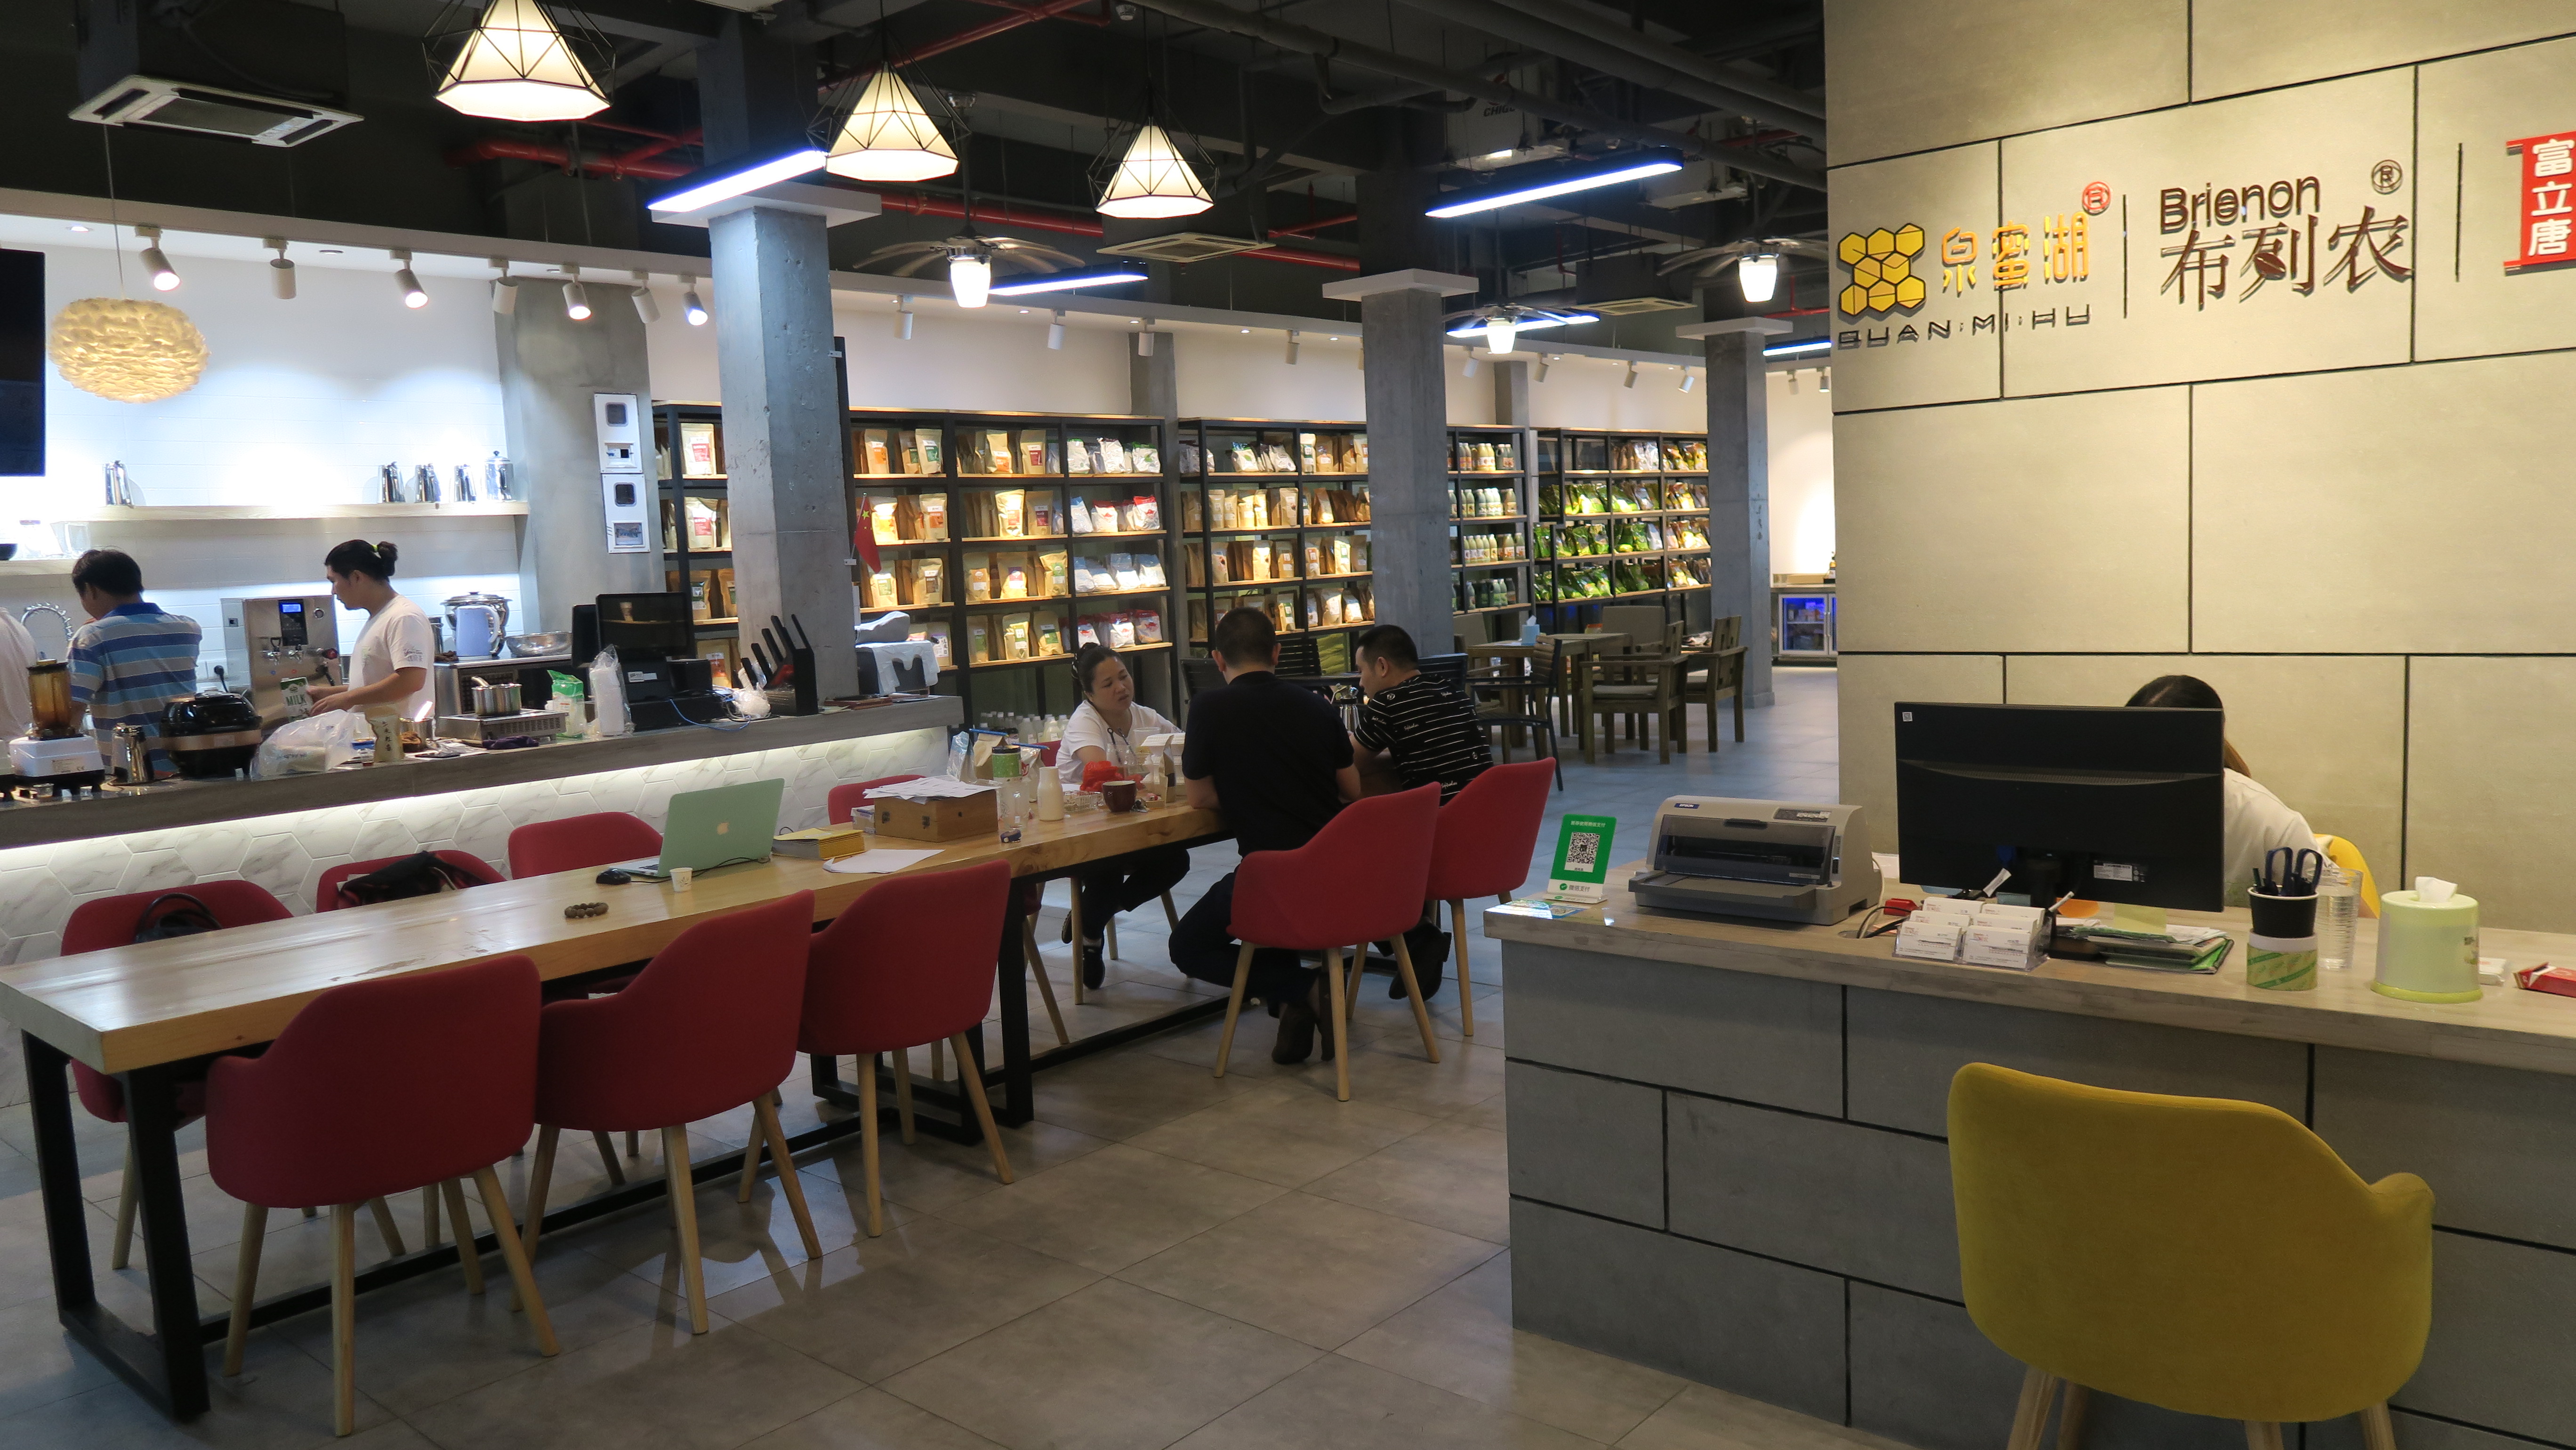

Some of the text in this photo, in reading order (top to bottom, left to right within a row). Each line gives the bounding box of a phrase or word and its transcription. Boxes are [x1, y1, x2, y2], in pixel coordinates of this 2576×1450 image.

[2160, 176, 2320, 234] Brienon
[2528, 138, 2575, 256] 富立唐
[1942, 211, 2089, 297] 泉蜜湖
[2160, 205, 2412, 312] 布列农
[286, 694, 307, 706] MILK
